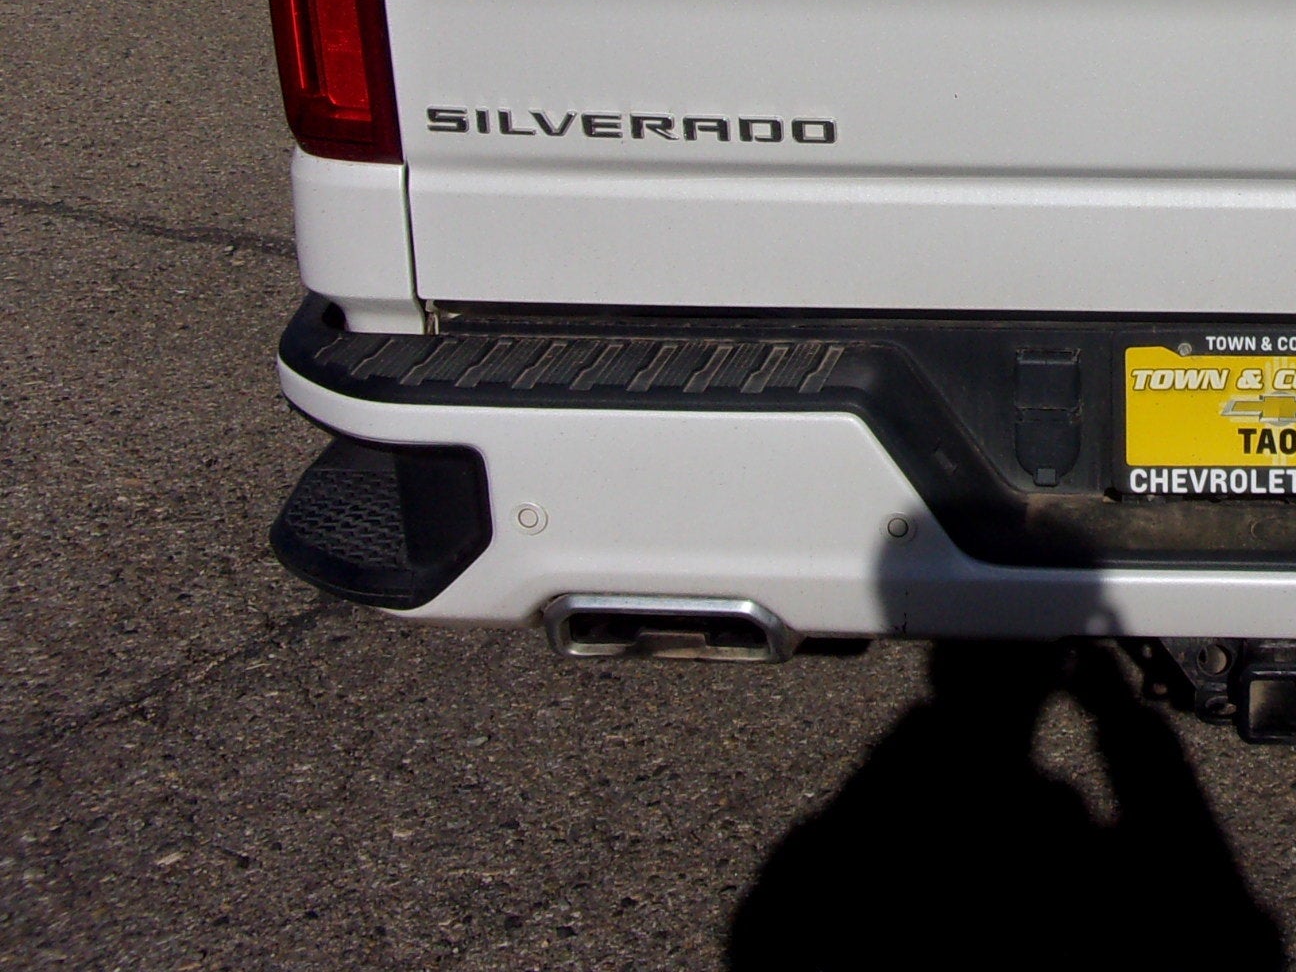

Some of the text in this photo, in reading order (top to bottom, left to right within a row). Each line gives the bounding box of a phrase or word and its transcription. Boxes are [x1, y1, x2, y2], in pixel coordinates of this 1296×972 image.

[427, 105, 837, 144] SILVERADO
[1206, 335, 1257, 352] TOWN
[1260, 336, 1273, 352] &
[1131, 369, 1230, 391] TOWN
[1236, 369, 1265, 391] &
